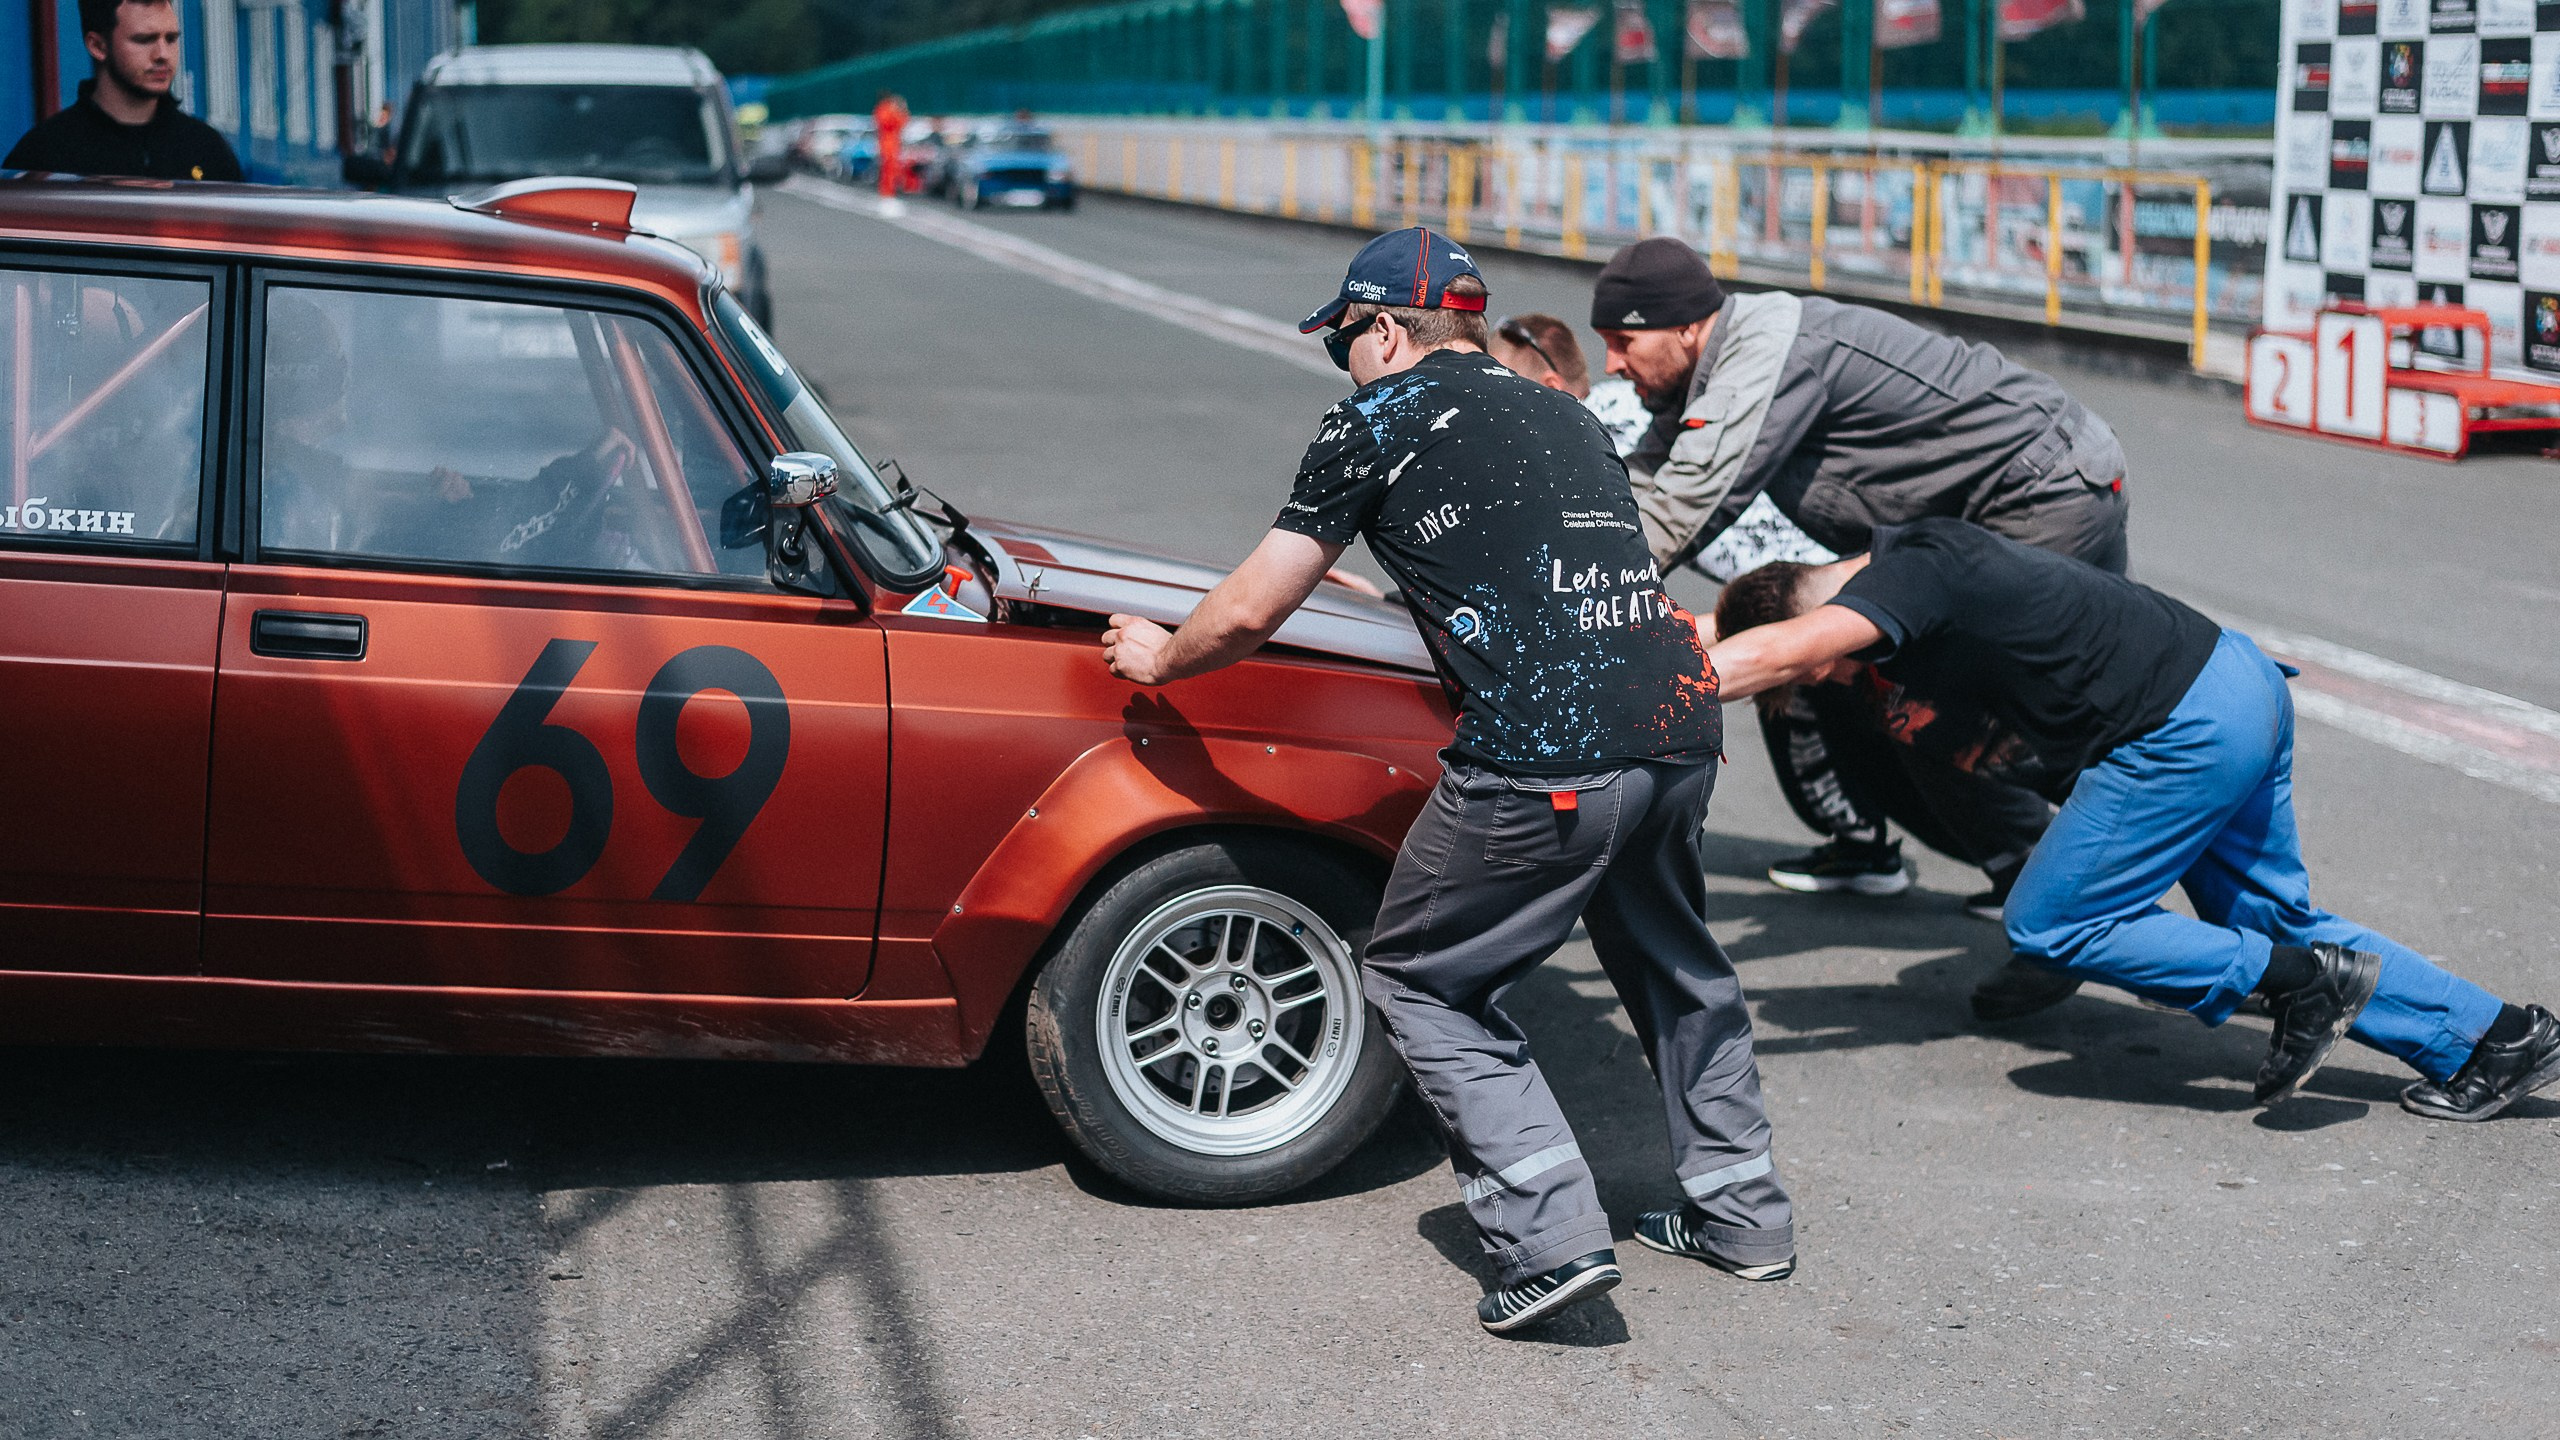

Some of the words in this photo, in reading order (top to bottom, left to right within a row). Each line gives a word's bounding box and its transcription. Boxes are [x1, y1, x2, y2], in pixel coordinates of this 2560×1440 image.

[1348, 280, 1387, 296] CarNext
[1362, 291, 1381, 301] .com
[2272, 351, 2290, 413] 2
[2338, 327, 2355, 419] 1
[1414, 503, 1460, 543] ING
[1561, 510, 1590, 519] Chinese
[1590, 510, 1614, 519] People
[1563, 519, 1596, 528] Celebrate
[1596, 519, 1621, 528] Chinese
[1552, 558, 1611, 592] Lets
[1579, 589, 1656, 631] GREAT
[455, 637, 792, 901] 69
